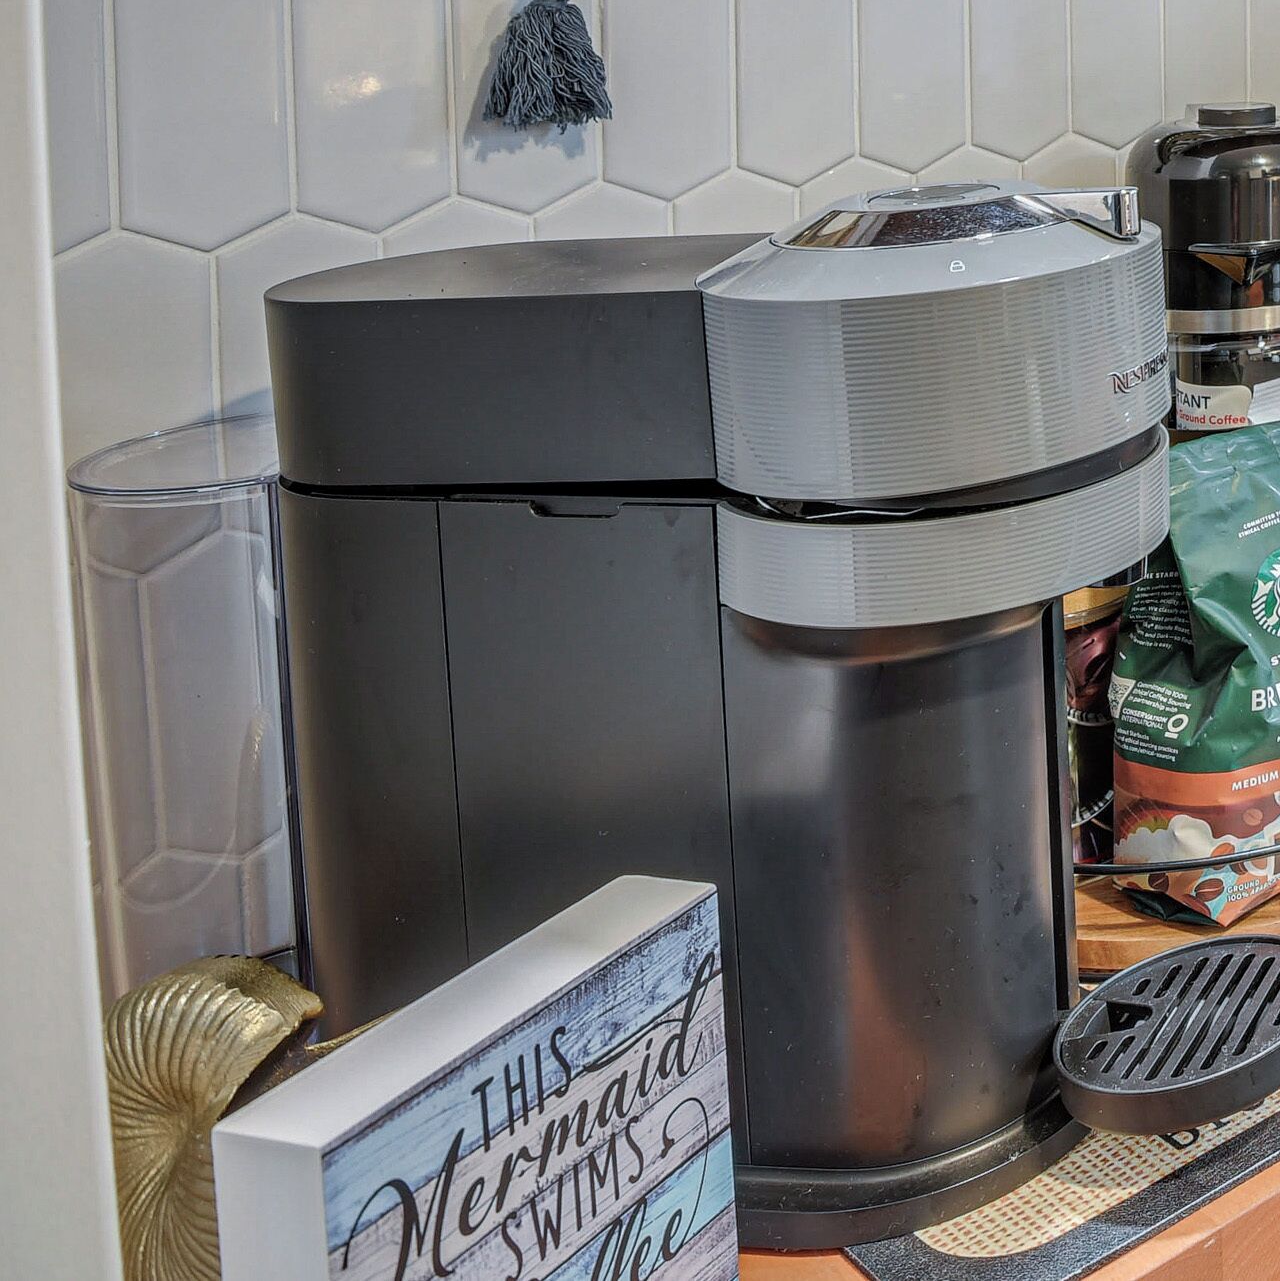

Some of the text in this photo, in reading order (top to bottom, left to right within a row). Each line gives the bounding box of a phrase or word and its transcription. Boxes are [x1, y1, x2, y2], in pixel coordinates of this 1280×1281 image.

[1209, 414, 1247, 426] Coffee
[1238, 525, 1261, 539] ETHICAL
[1260, 518, 1280, 530] COFFEE
[1243, 513, 1276, 530] COMMITTED
[1137, 681, 1166, 694] Committed
[1121, 715, 1163, 730] INTERNATIONAL
[1122, 707, 1168, 723] CONSERVATION
[1231, 770, 1279, 791] MEDIUM
[1227, 879, 1260, 894] GROUND
[1227, 889, 1249, 903] 100%
[472, 1026, 573, 1152] THIS
[342, 952, 720, 1281] Mermaid
[501, 1115, 645, 1281] SWIMS
